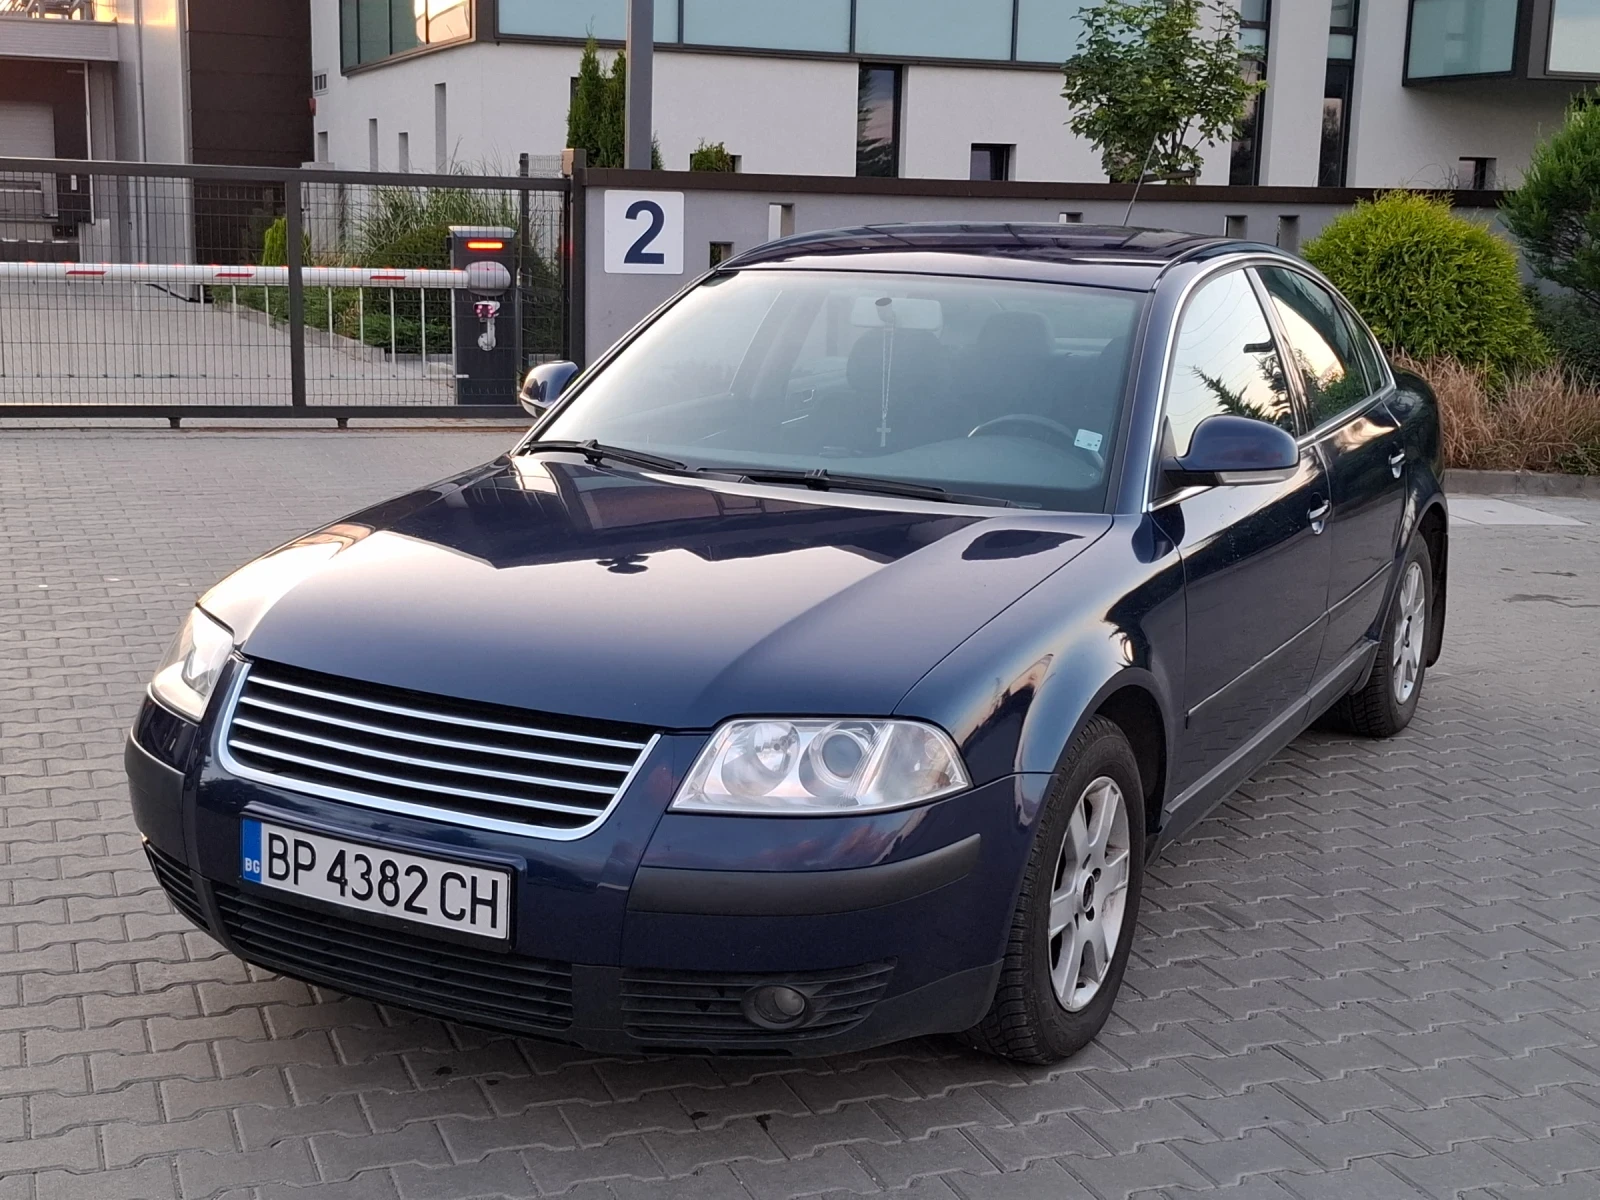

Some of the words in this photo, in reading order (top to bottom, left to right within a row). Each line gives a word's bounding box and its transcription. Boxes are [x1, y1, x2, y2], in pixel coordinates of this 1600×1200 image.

[624, 200, 664, 264] 2
[245, 857, 260, 874] BG
[268, 832, 316, 885] BP
[326, 849, 428, 915] 4382
[440, 872, 498, 929] CH
